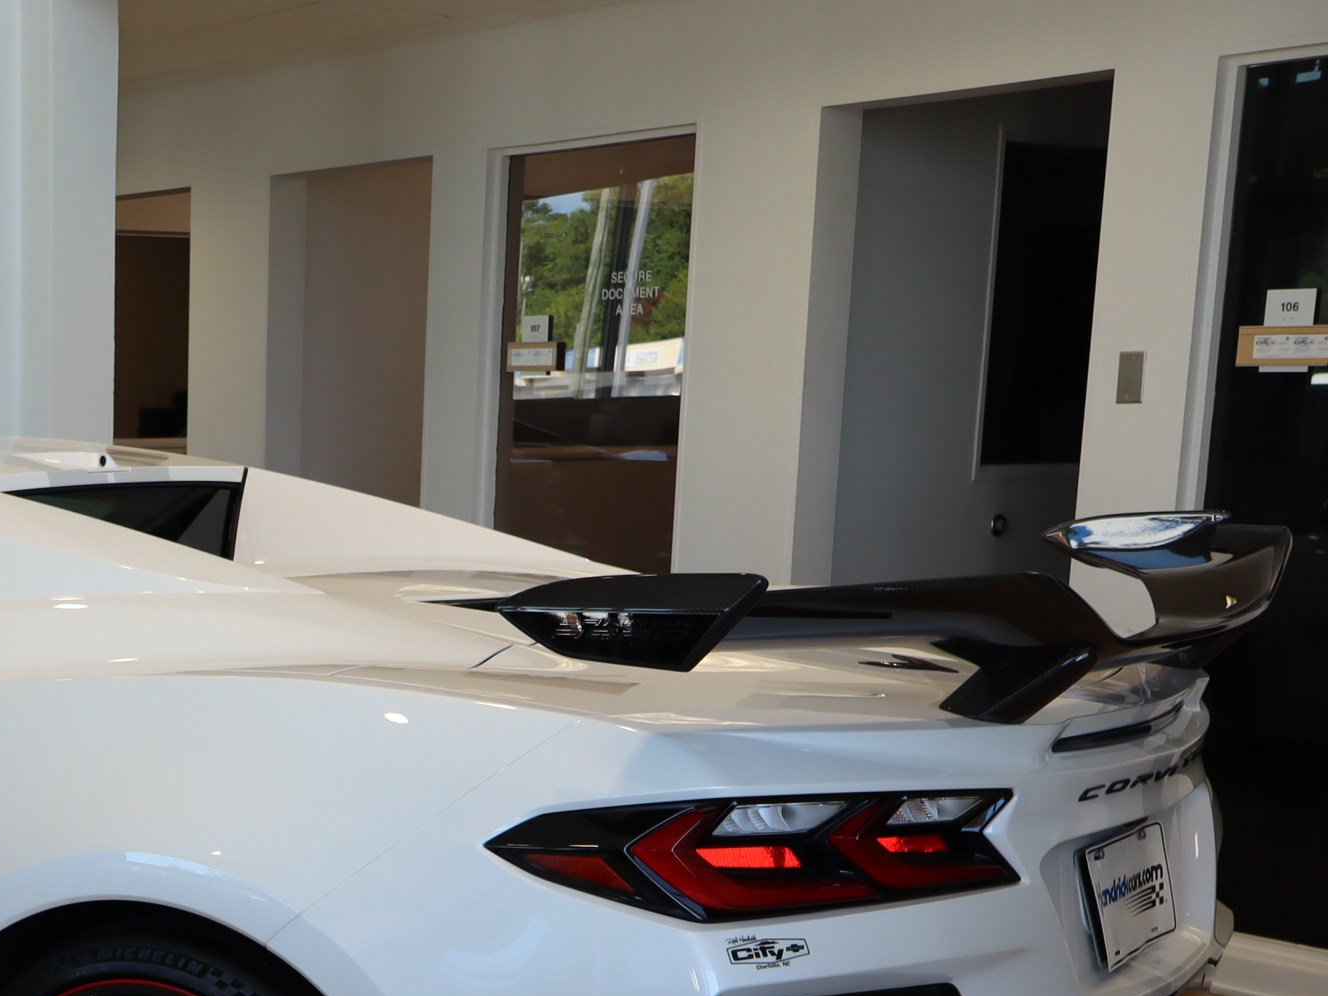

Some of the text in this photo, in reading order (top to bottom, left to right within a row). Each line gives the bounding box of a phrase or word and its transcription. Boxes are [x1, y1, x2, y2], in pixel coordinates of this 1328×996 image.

[602, 286, 660, 300] DOCMENT
[615, 303, 644, 316] AEA
[1281, 301, 1299, 312] 106
[97, 947, 204, 976] MICHELIN
